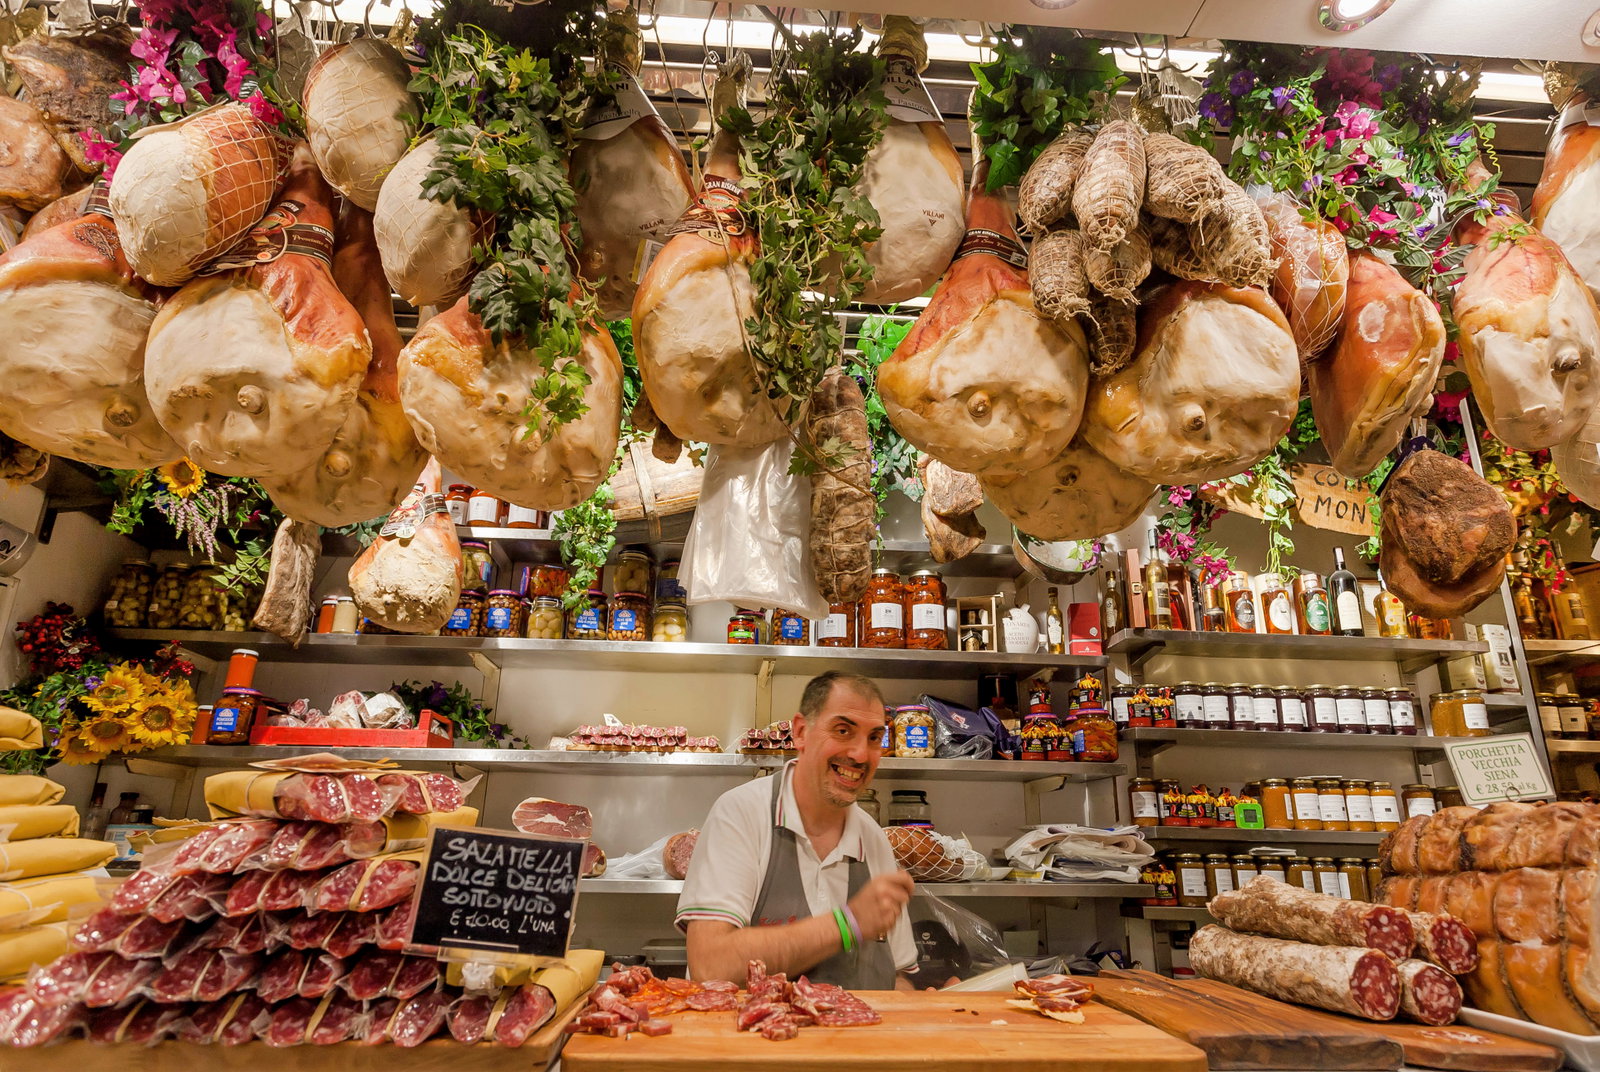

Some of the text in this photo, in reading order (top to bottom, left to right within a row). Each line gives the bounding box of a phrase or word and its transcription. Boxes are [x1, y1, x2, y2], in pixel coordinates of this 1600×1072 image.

[922, 209, 945, 220] VILLANI
[639, 218, 665, 231] VILLANI
[1458, 744, 1526, 760] PORCHETTA
[1471, 756, 1522, 770] VECCHIA
[1484, 769, 1519, 781] SIENA
[1476, 784, 1484, 794] €
[442, 837, 573, 874] SALAMELLA
[432, 861, 498, 887] DOLCE
[518, 914, 557, 935] L'UNA
